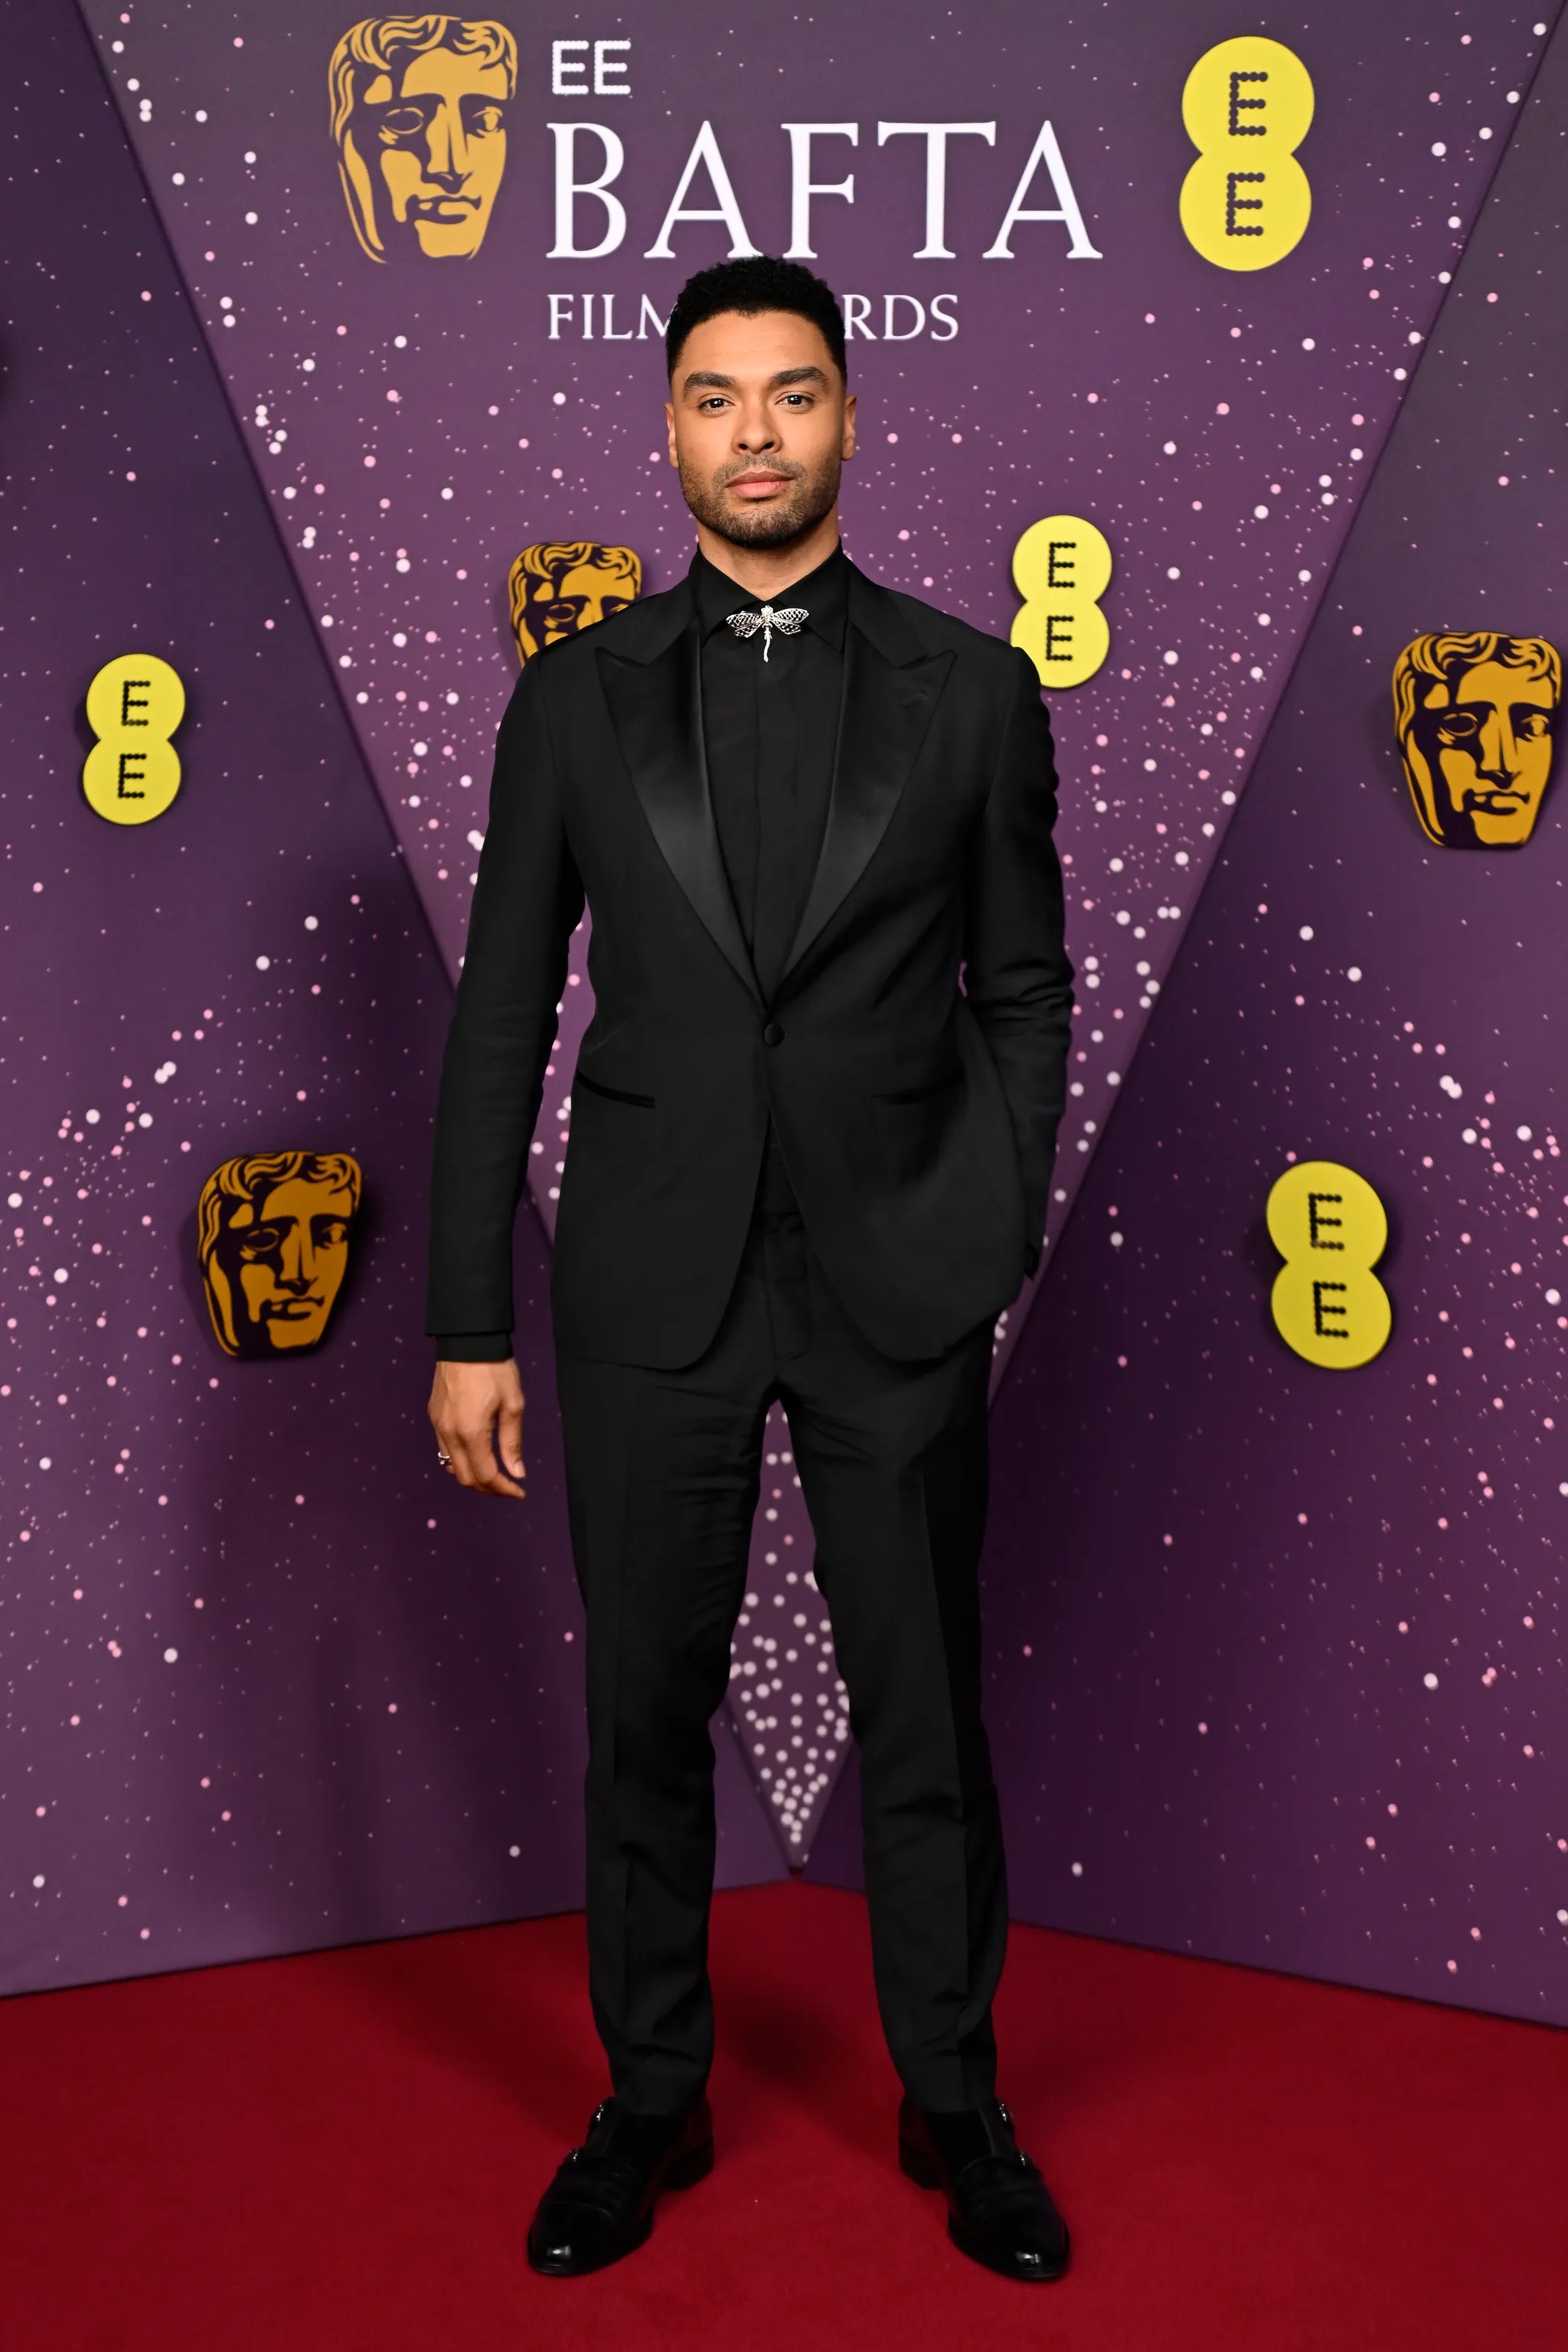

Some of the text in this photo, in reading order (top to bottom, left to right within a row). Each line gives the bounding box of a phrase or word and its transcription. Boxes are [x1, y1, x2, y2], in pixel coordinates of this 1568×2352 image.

[552, 40, 632, 95] EE
[546, 120, 1103, 259] BAFTA
[547, 293, 959, 341] FILM RDS
